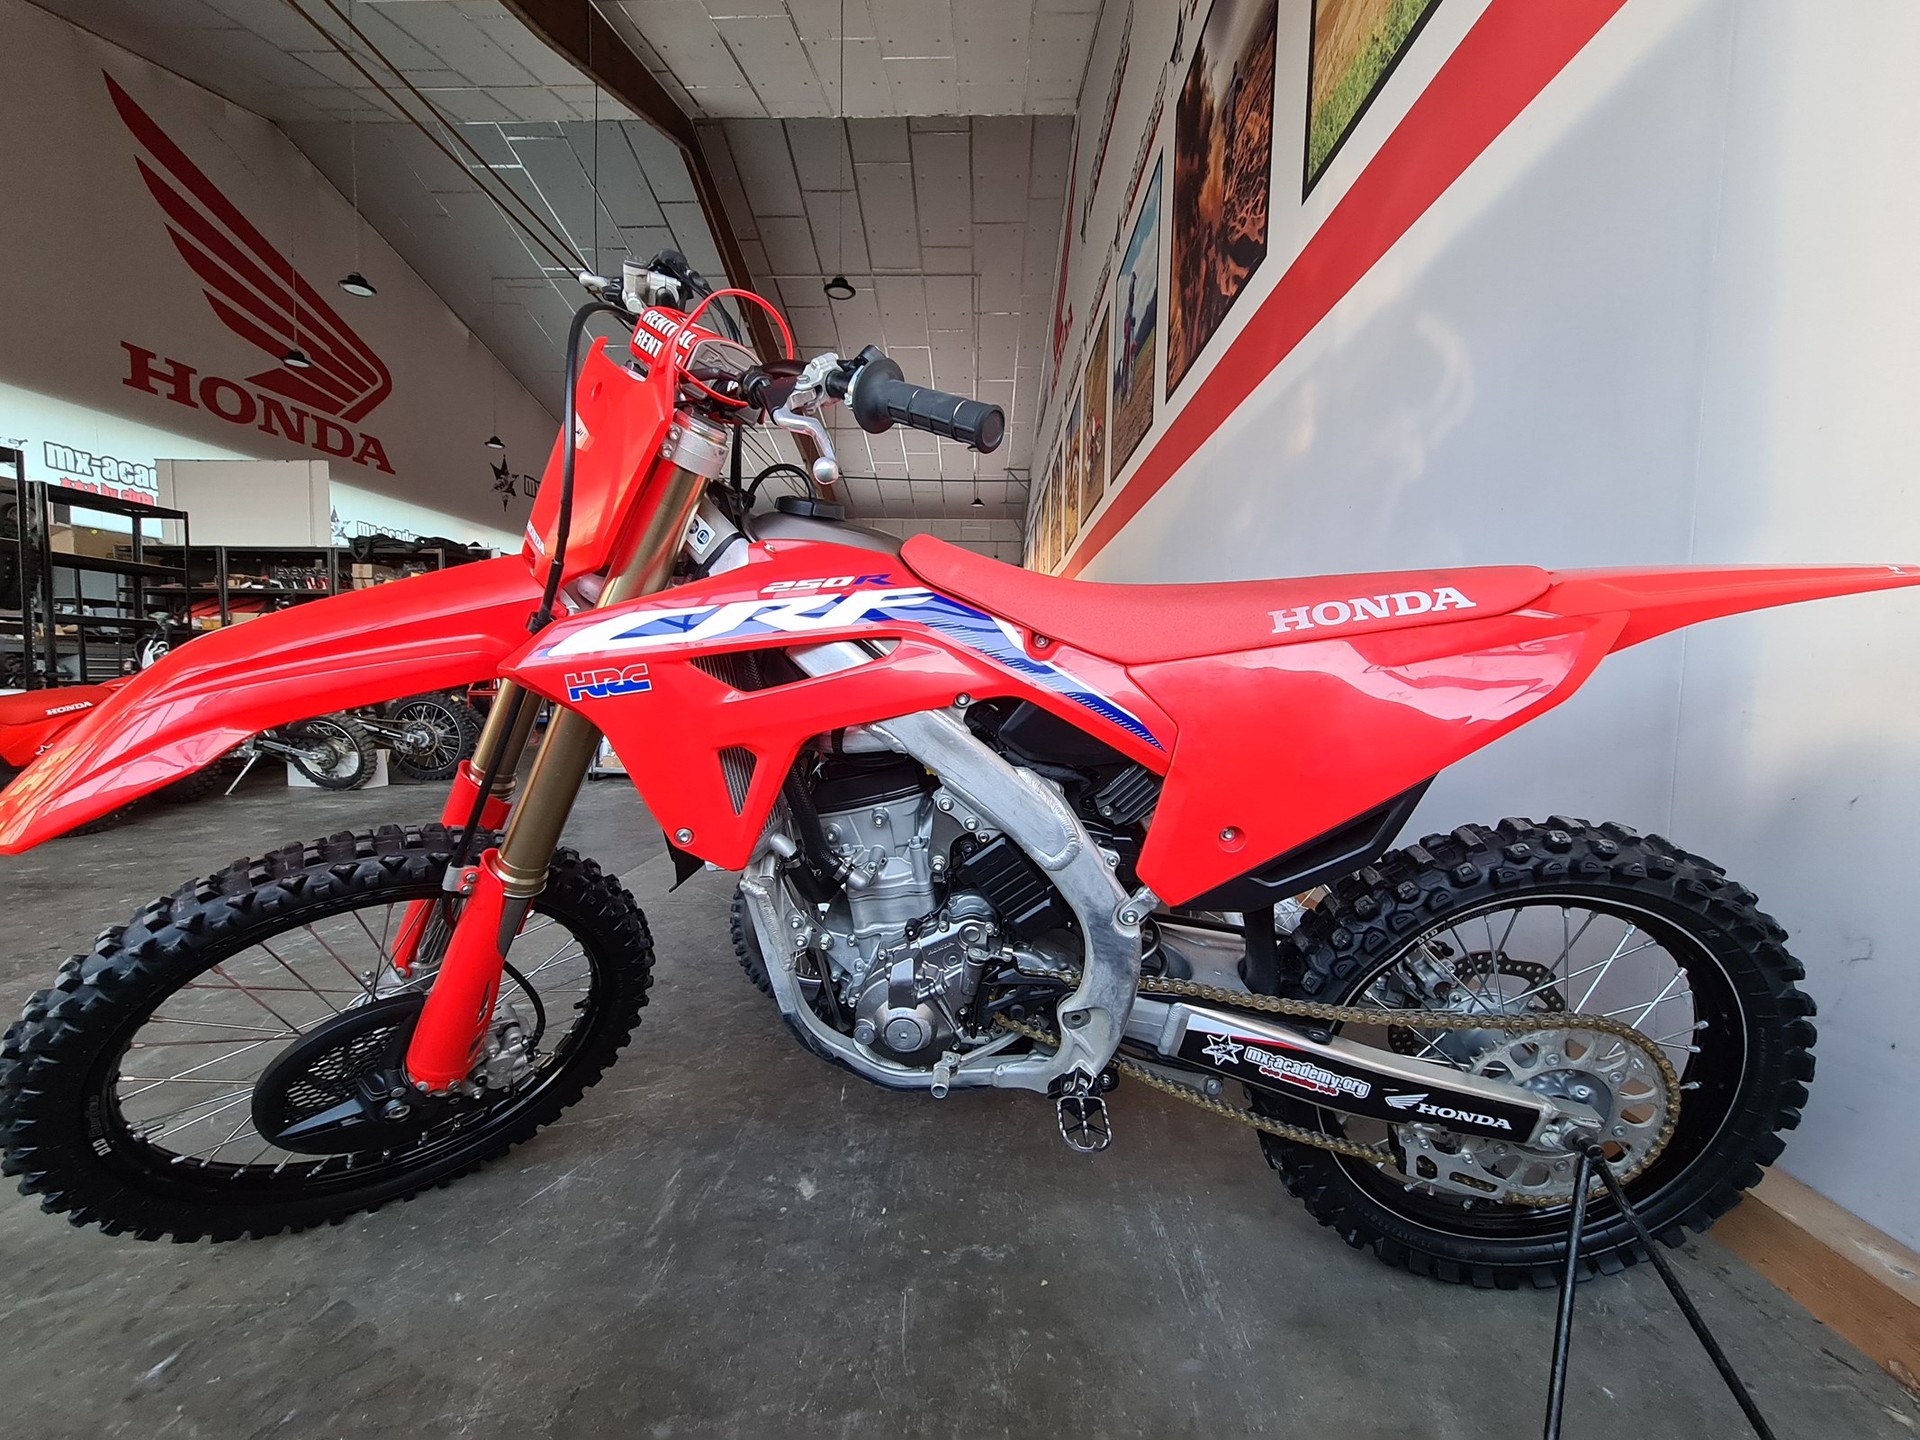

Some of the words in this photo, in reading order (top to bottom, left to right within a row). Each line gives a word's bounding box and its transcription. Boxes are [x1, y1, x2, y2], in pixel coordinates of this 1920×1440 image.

[120, 340, 396, 475] HONDA
[760, 573, 896, 593] 250R
[546, 587, 937, 657] CRF
[1267, 587, 1477, 634] HONDA
[564, 663, 652, 702] HRC
[45, 701, 93, 716] HONDA
[1244, 1046, 1371, 1098] mx-academy.org
[1416, 1102, 1513, 1131] HONDA
